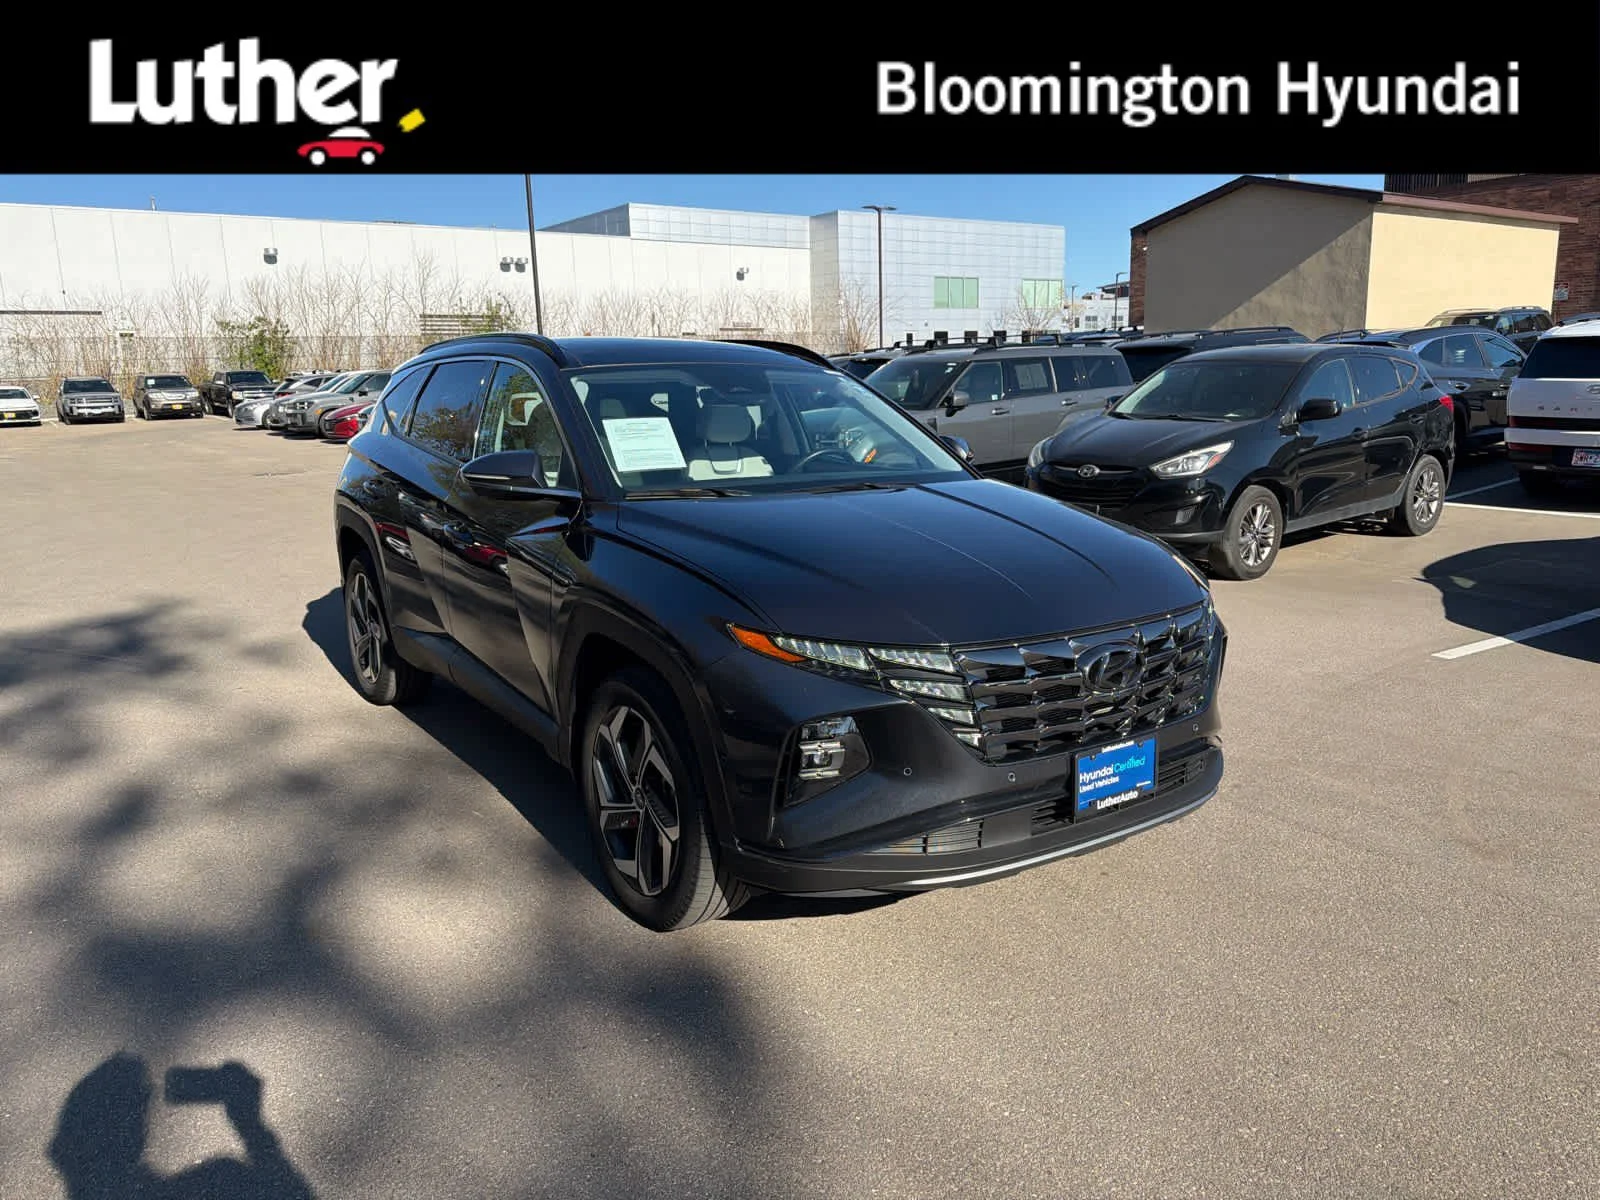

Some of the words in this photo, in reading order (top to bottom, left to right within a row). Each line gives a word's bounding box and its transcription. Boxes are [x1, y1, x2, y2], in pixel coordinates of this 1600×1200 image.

[1079, 764, 1114, 783] Hyundai
[1114, 756, 1145, 773] Certified
[1096, 790, 1138, 810] LutherAuto
